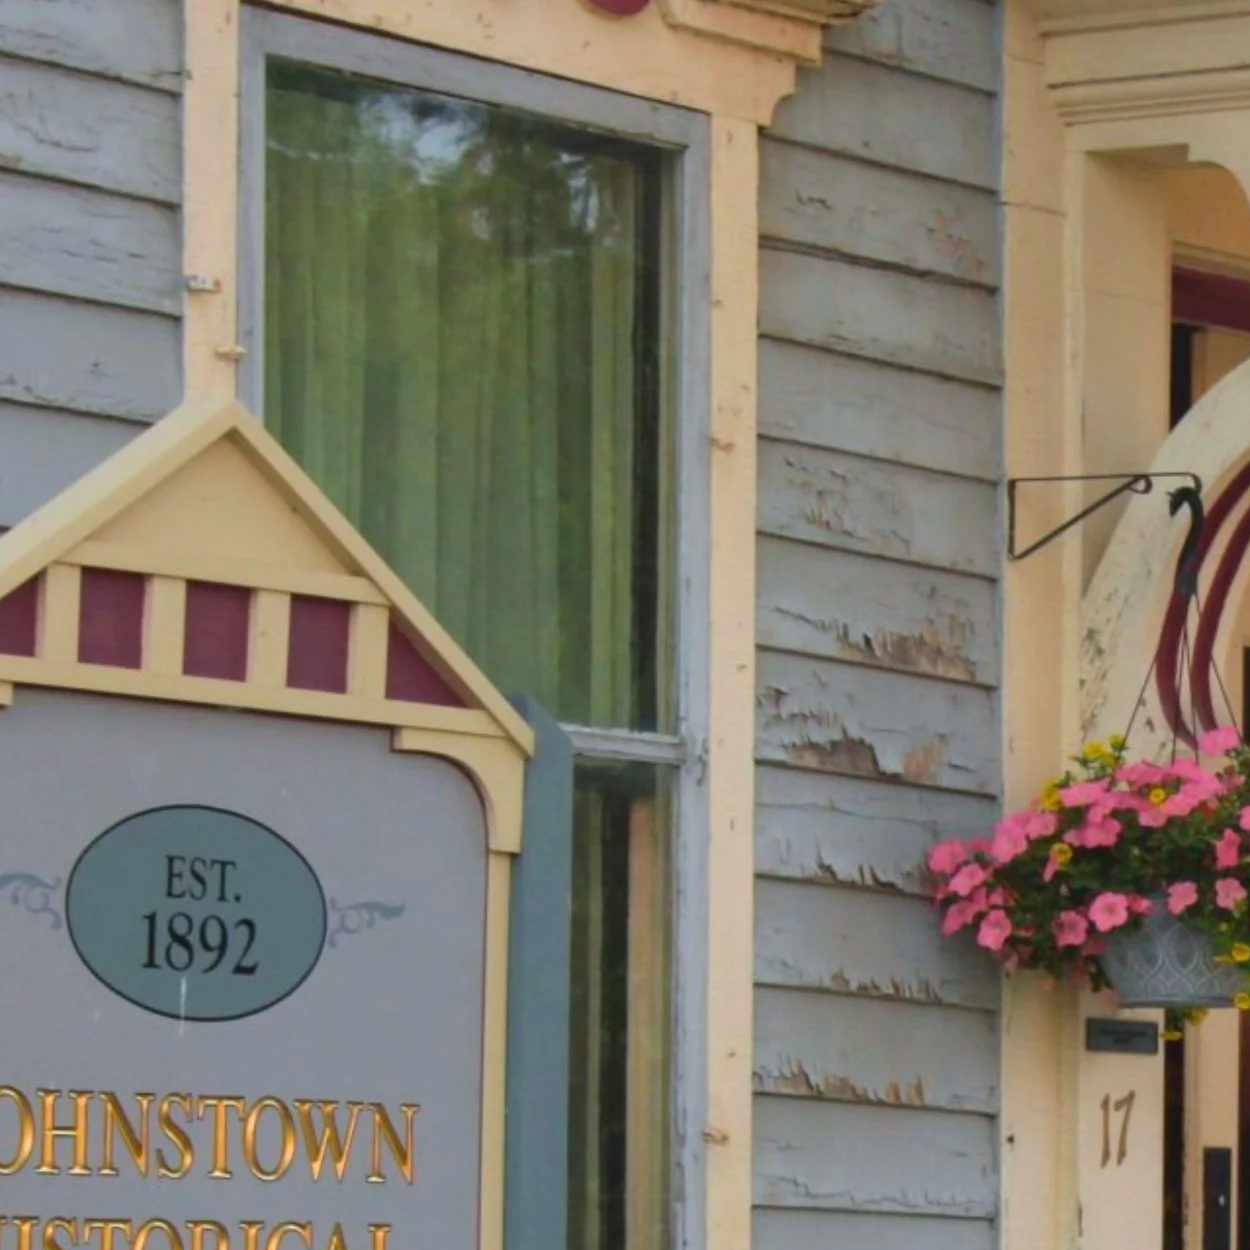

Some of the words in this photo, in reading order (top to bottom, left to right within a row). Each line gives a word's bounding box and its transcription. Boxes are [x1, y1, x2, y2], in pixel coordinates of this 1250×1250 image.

[164, 854, 242, 903] EST.
[140, 910, 259, 976] 1892
[1100, 1089, 1136, 1170] 17
